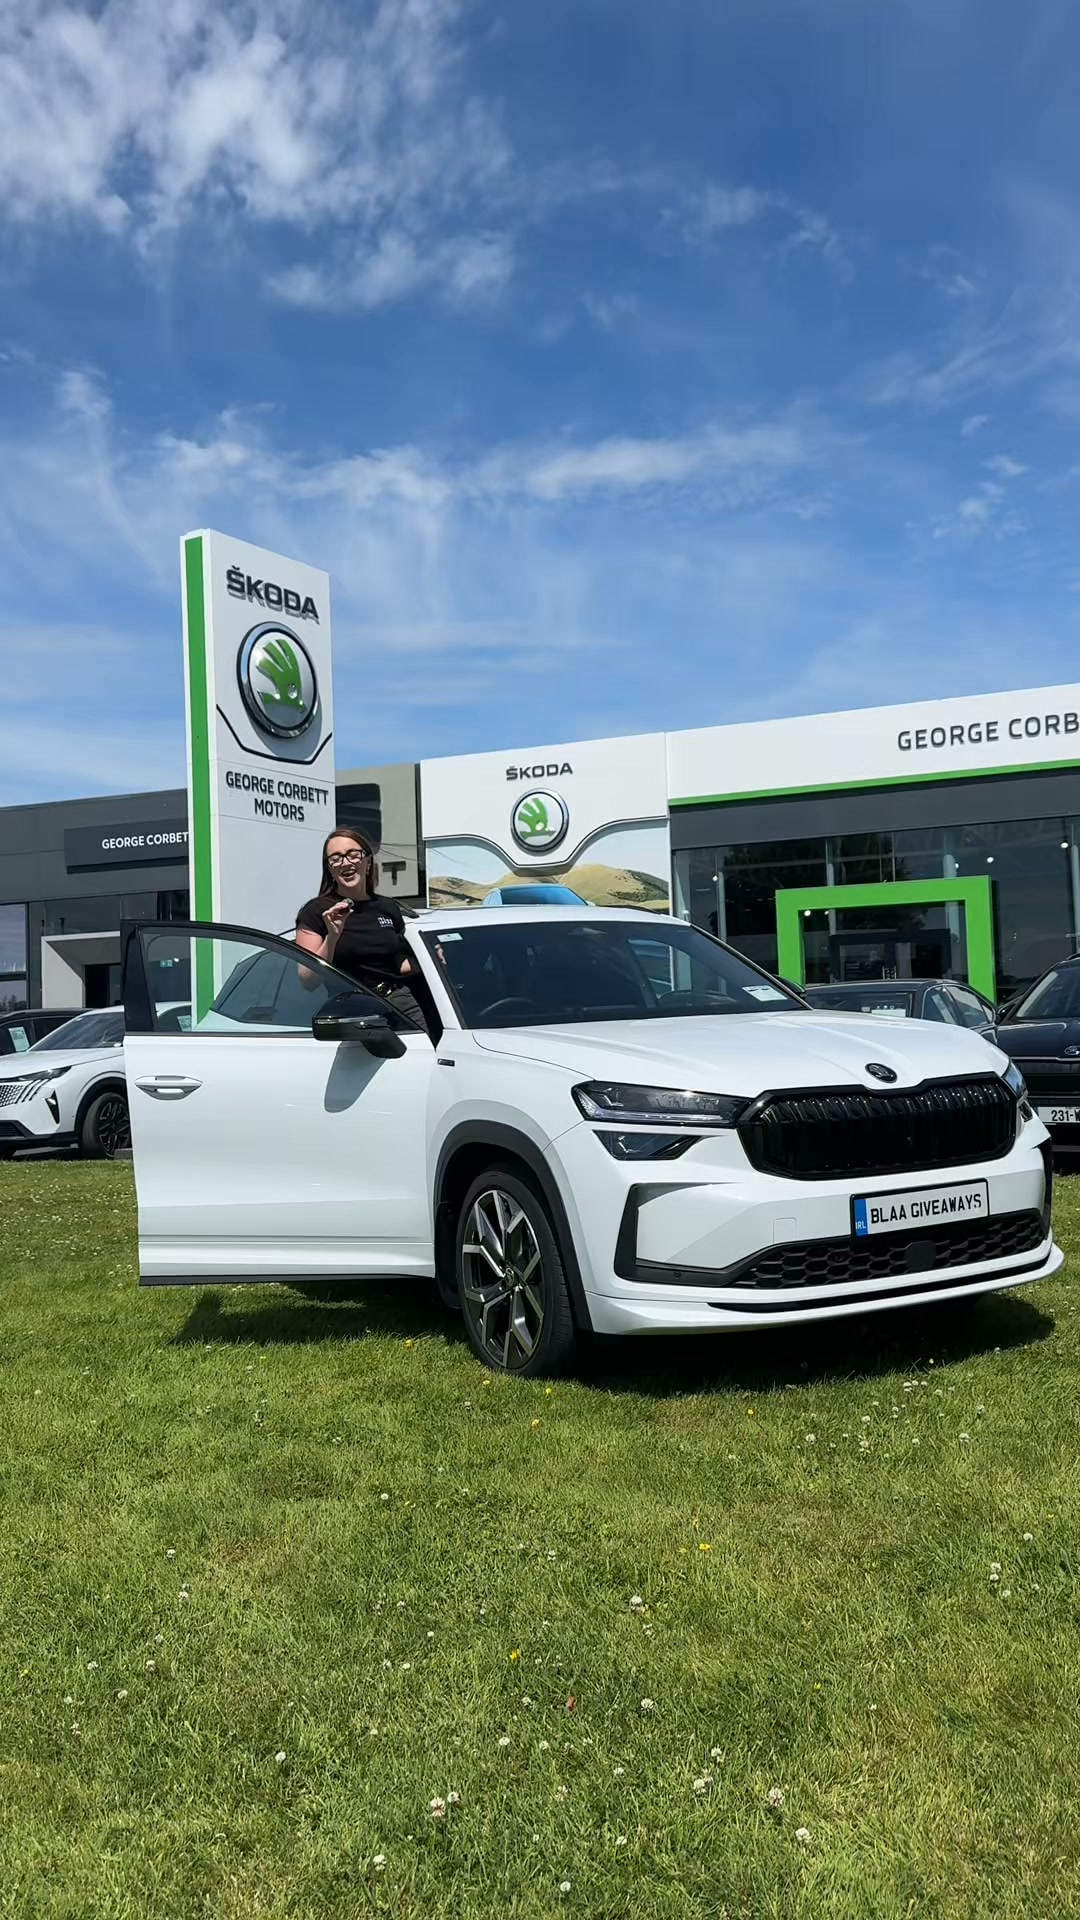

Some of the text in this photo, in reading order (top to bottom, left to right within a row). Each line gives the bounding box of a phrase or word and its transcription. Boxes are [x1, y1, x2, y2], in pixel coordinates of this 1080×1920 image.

[226, 565, 319, 619] ŠKODA
[897, 712, 1080, 751] GEORGE CORB
[506, 762, 573, 781] ŠKODA
[226, 771, 329, 806] GEORGE CORBETT
[254, 798, 305, 822] MOTORS
[102, 836, 145, 849] GEORGE
[870, 1193, 982, 1224] BLAA GIVEAWAYS
[855, 1220, 867, 1230] IRL
